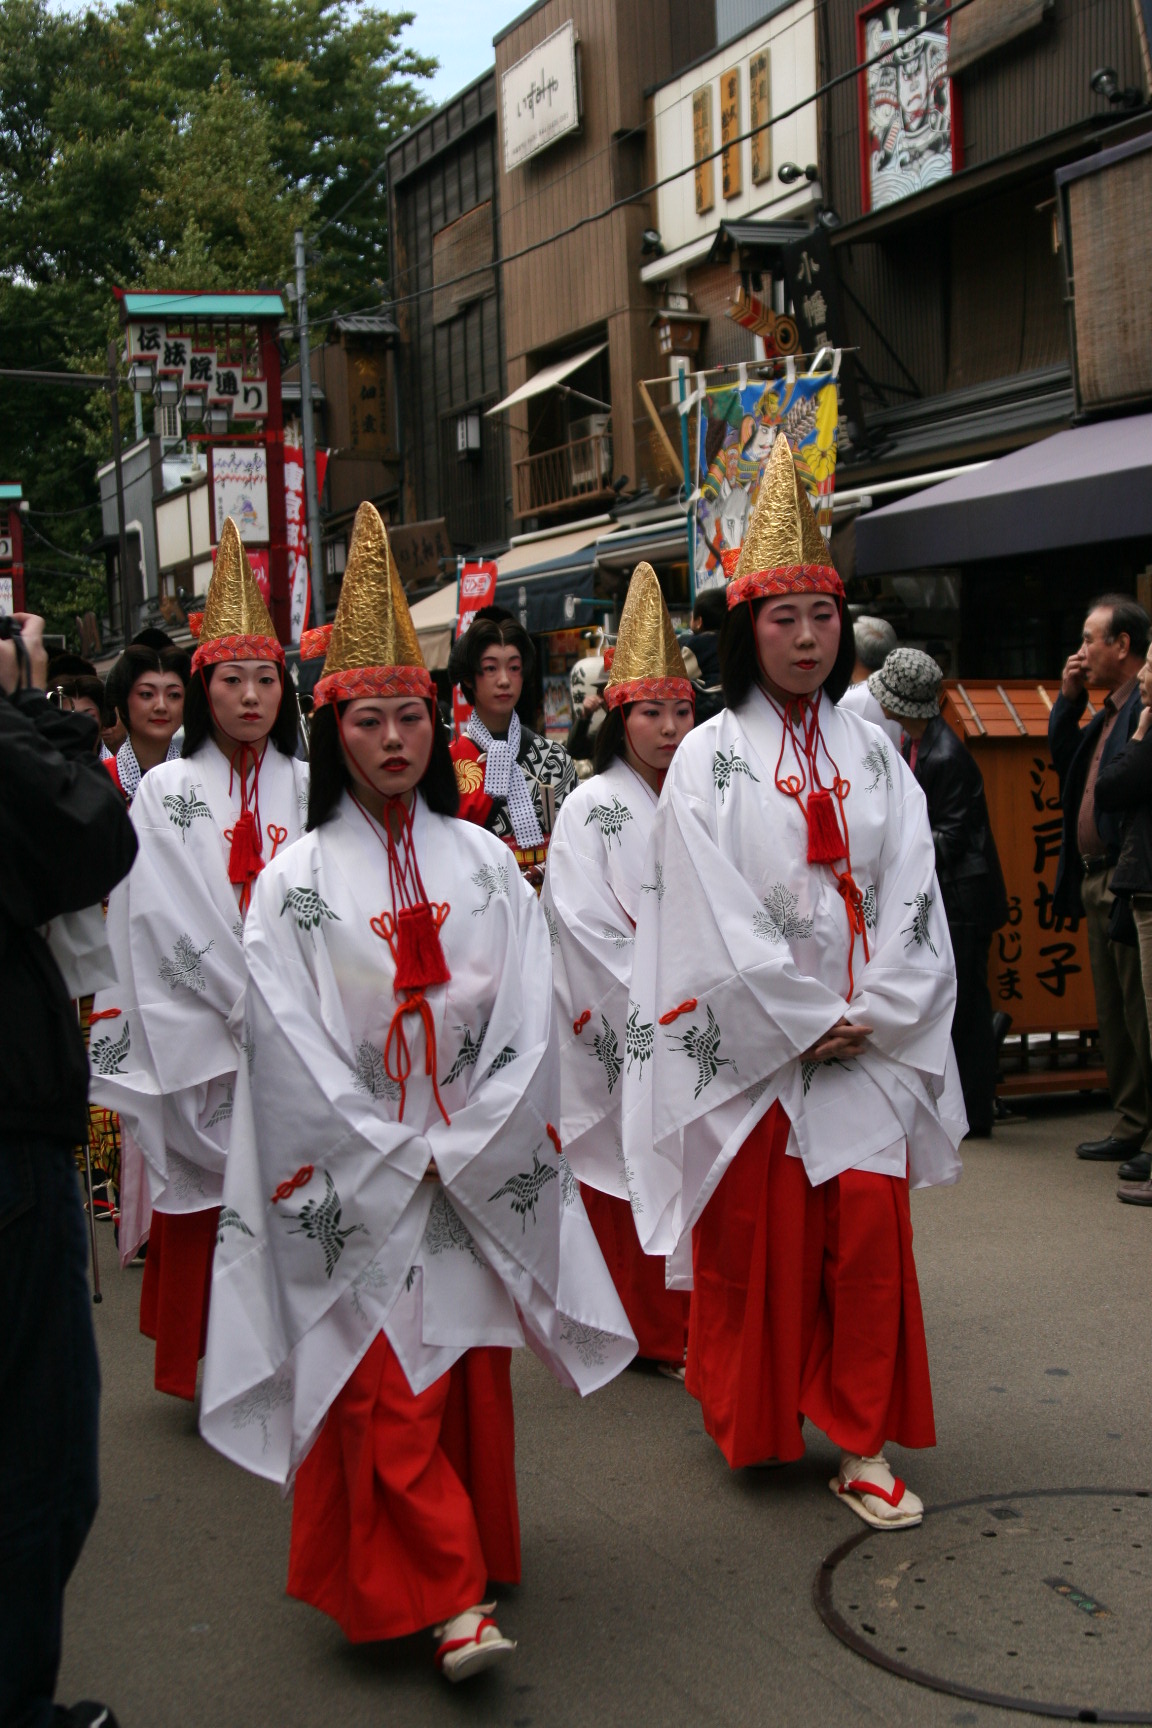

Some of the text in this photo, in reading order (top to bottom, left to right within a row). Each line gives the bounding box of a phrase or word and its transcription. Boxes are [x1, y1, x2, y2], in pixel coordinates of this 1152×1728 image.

[137, 325, 263, 411] 伝法院通り
